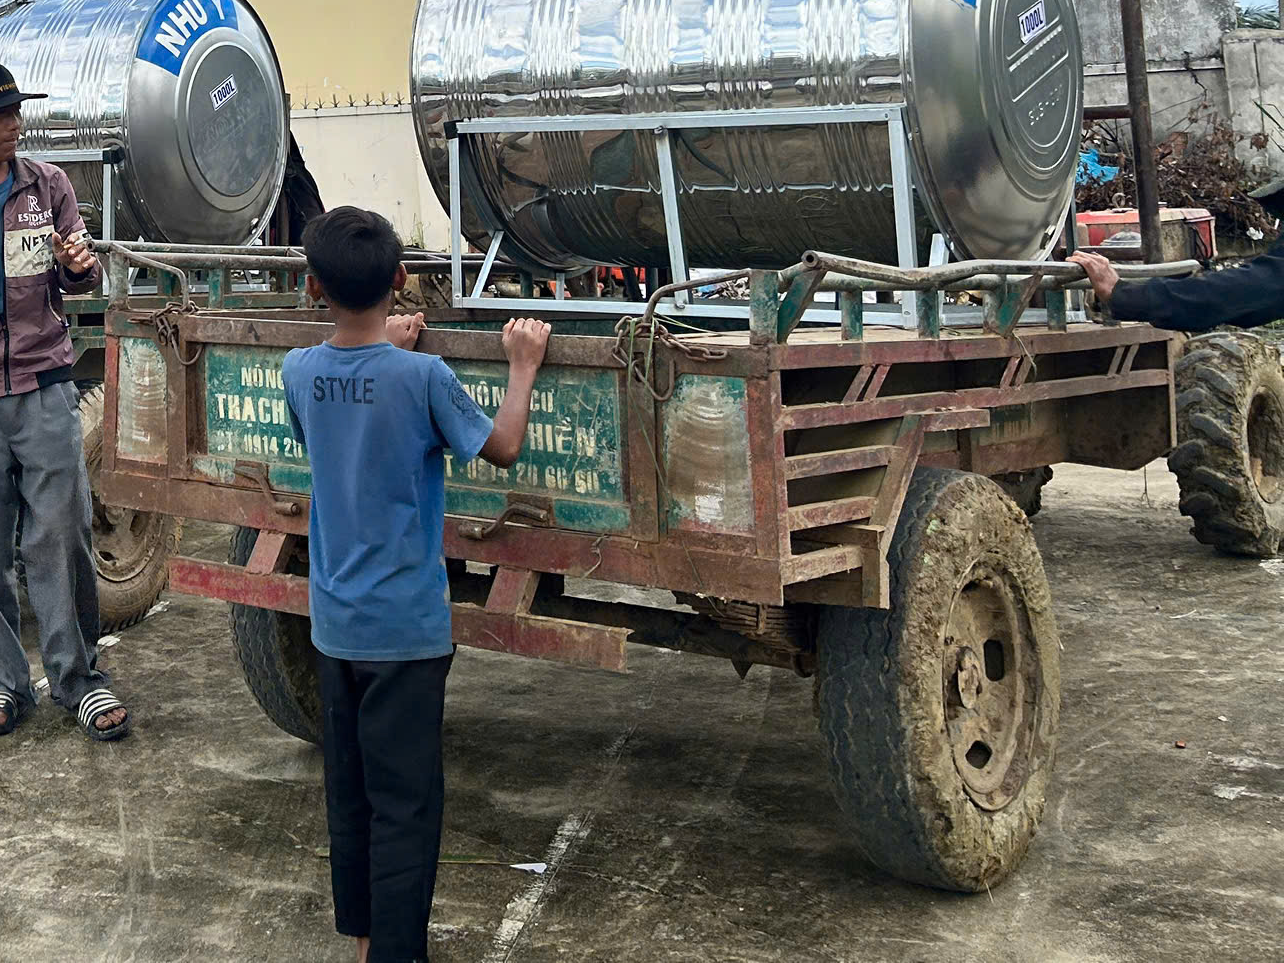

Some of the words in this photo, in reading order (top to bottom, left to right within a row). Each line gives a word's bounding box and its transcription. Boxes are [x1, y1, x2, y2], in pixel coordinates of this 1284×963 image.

[1020, 8, 1044, 36] 1000L
[213, 80, 236, 104] 1000L
[313, 375, 374, 404] STYLE
[462, 381, 507, 407] NÔN
[215, 393, 285, 427] THẠCH
[244, 433, 279, 455] 0914
